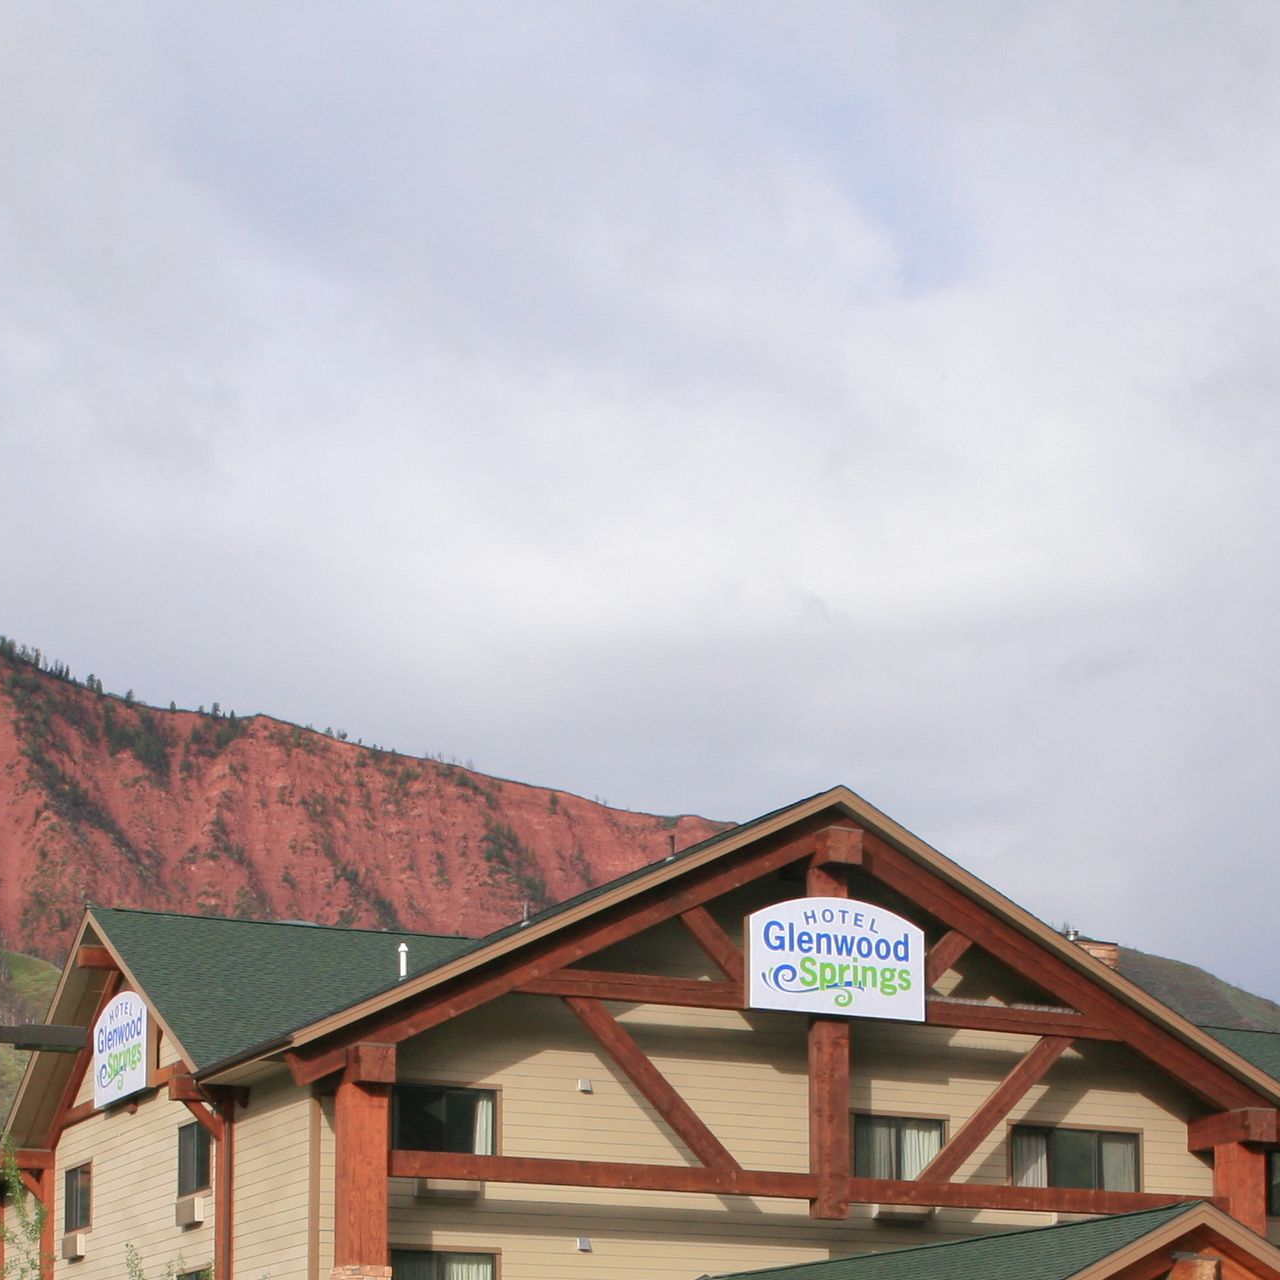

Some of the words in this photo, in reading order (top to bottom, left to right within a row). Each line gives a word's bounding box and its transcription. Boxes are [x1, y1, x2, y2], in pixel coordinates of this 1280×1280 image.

[803, 908, 879, 934] HOTEL
[763, 920, 910, 962] Glenwood
[799, 956, 912, 996] Springs
[97, 1008, 143, 1055] Glenwood
[109, 1001, 133, 1024] HOTEL
[107, 1042, 142, 1080] Springs
